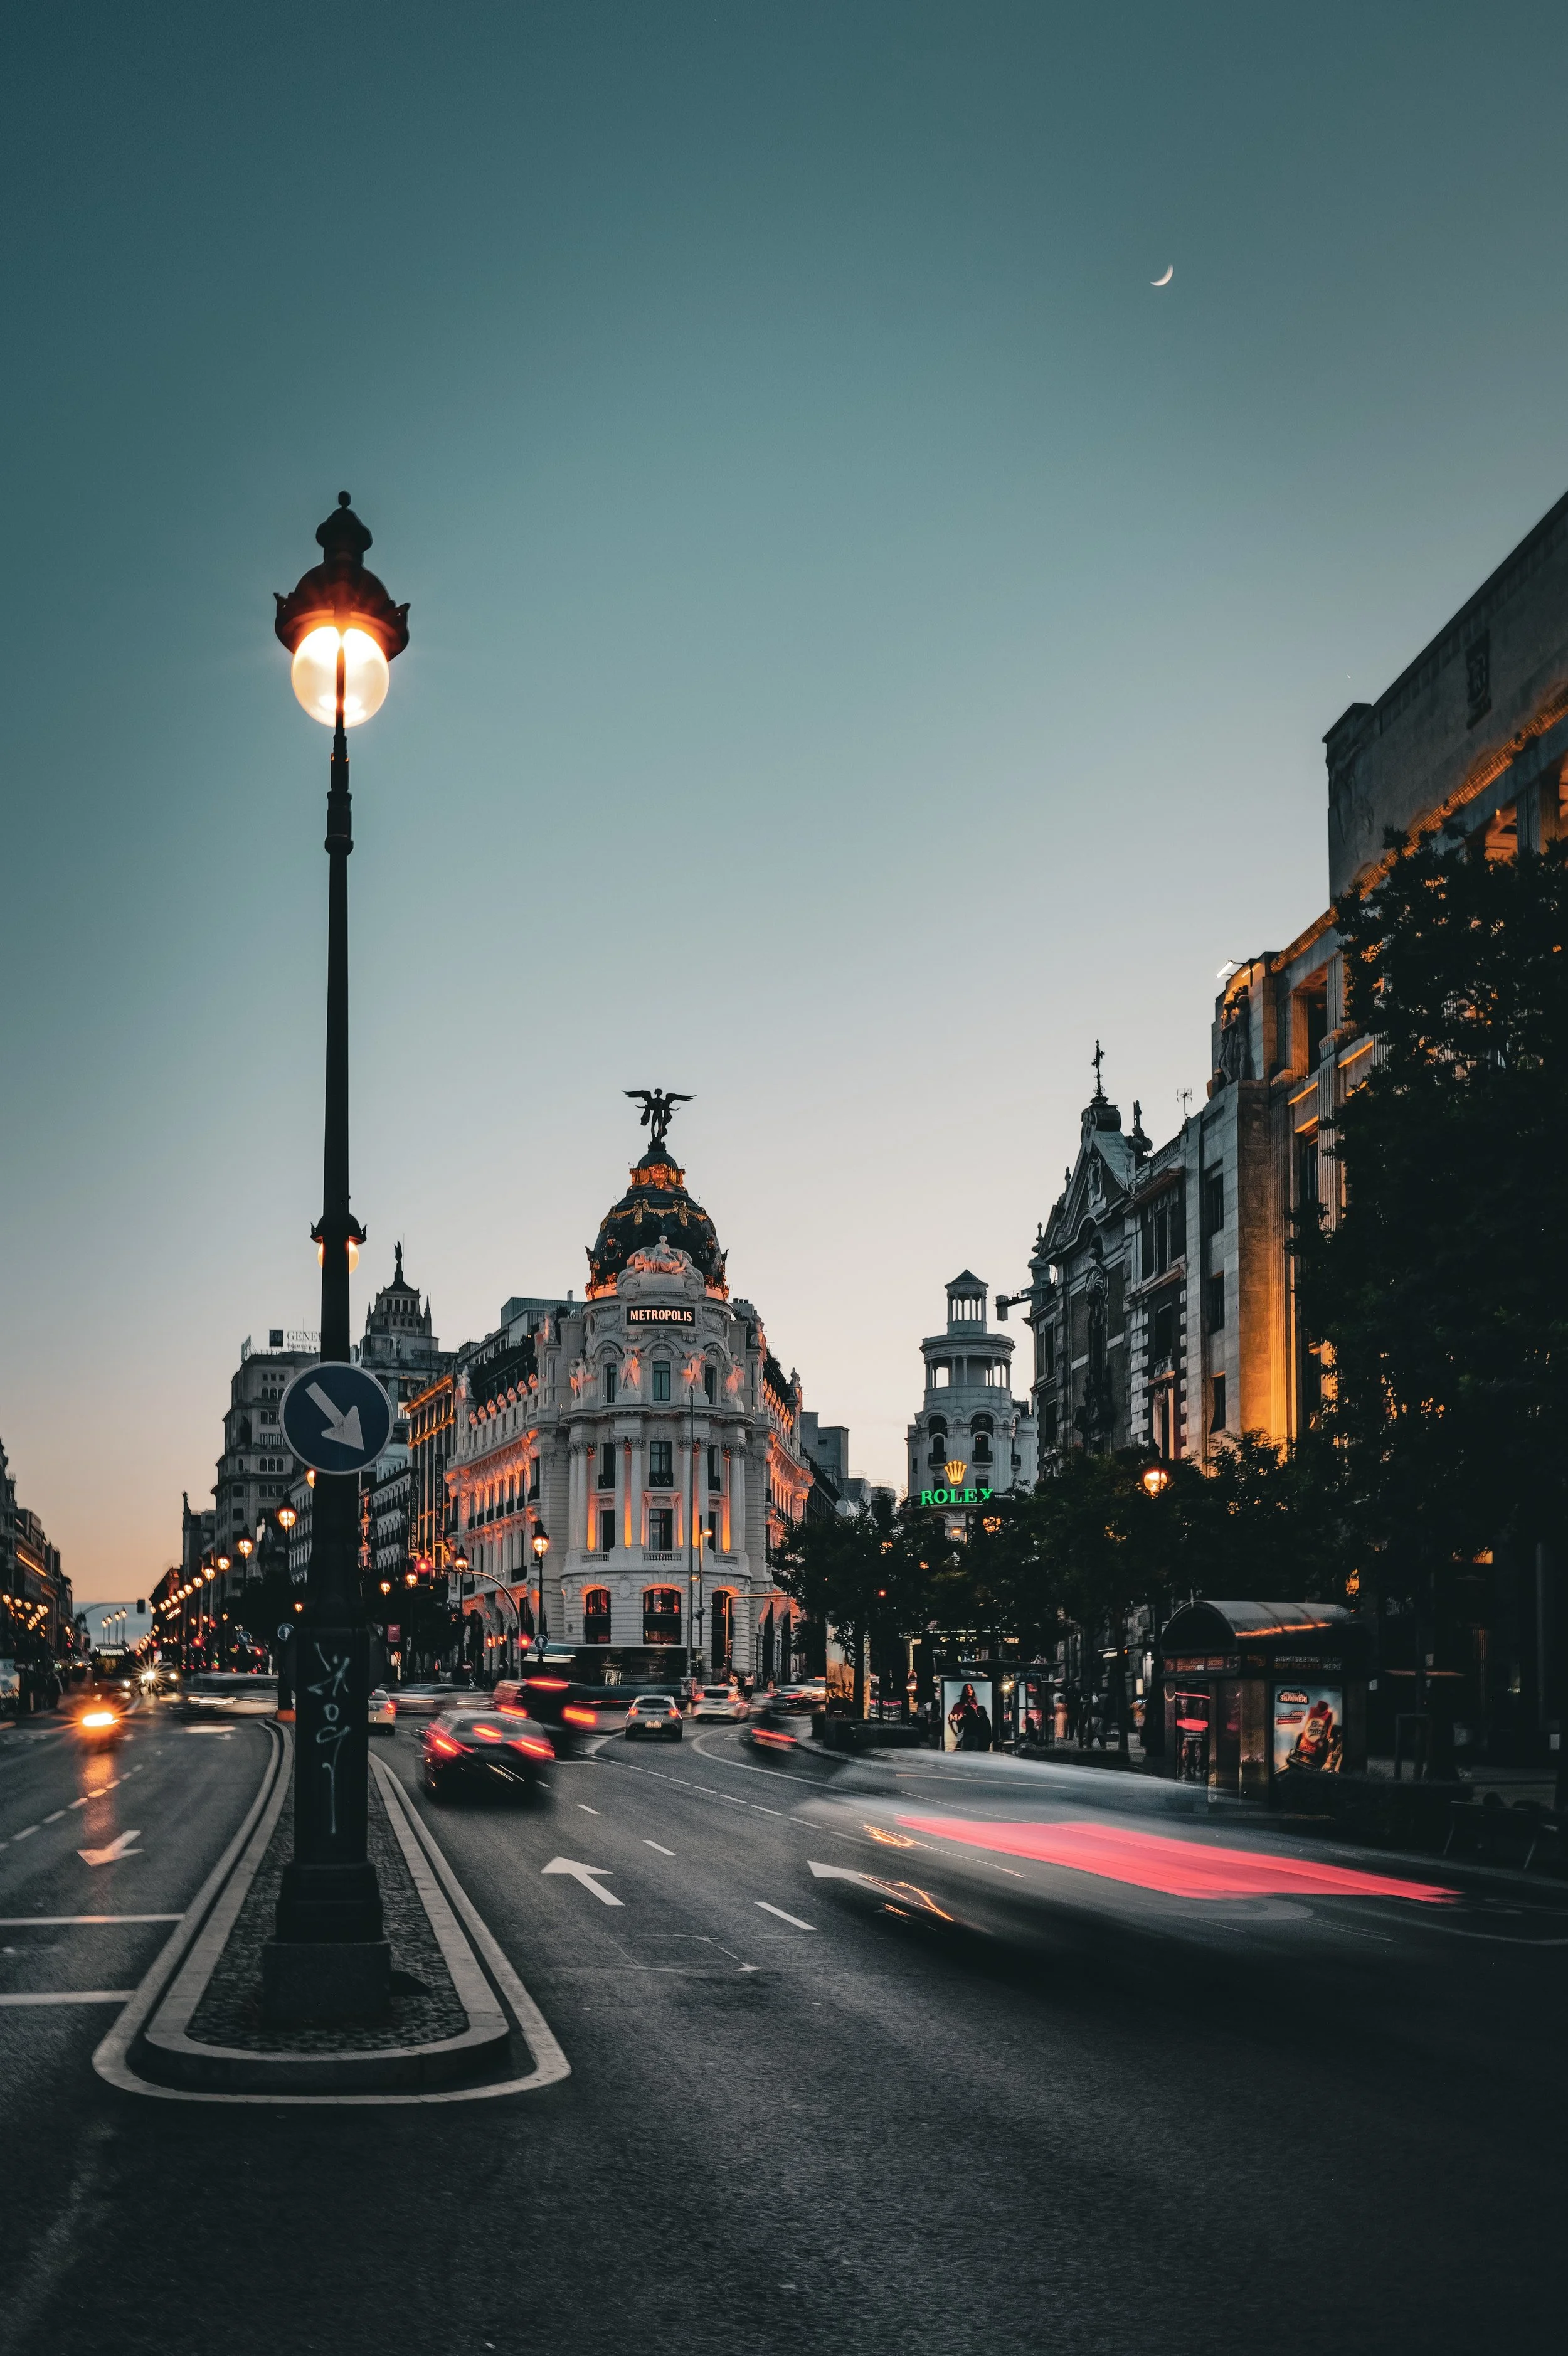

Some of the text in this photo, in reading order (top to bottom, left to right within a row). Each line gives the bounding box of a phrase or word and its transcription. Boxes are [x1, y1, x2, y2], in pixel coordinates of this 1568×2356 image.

[630, 1310, 692, 1322] METROPOLIS
[287, 1331, 322, 1342] GENE
[920, 1488, 994, 1505] ROLEX
